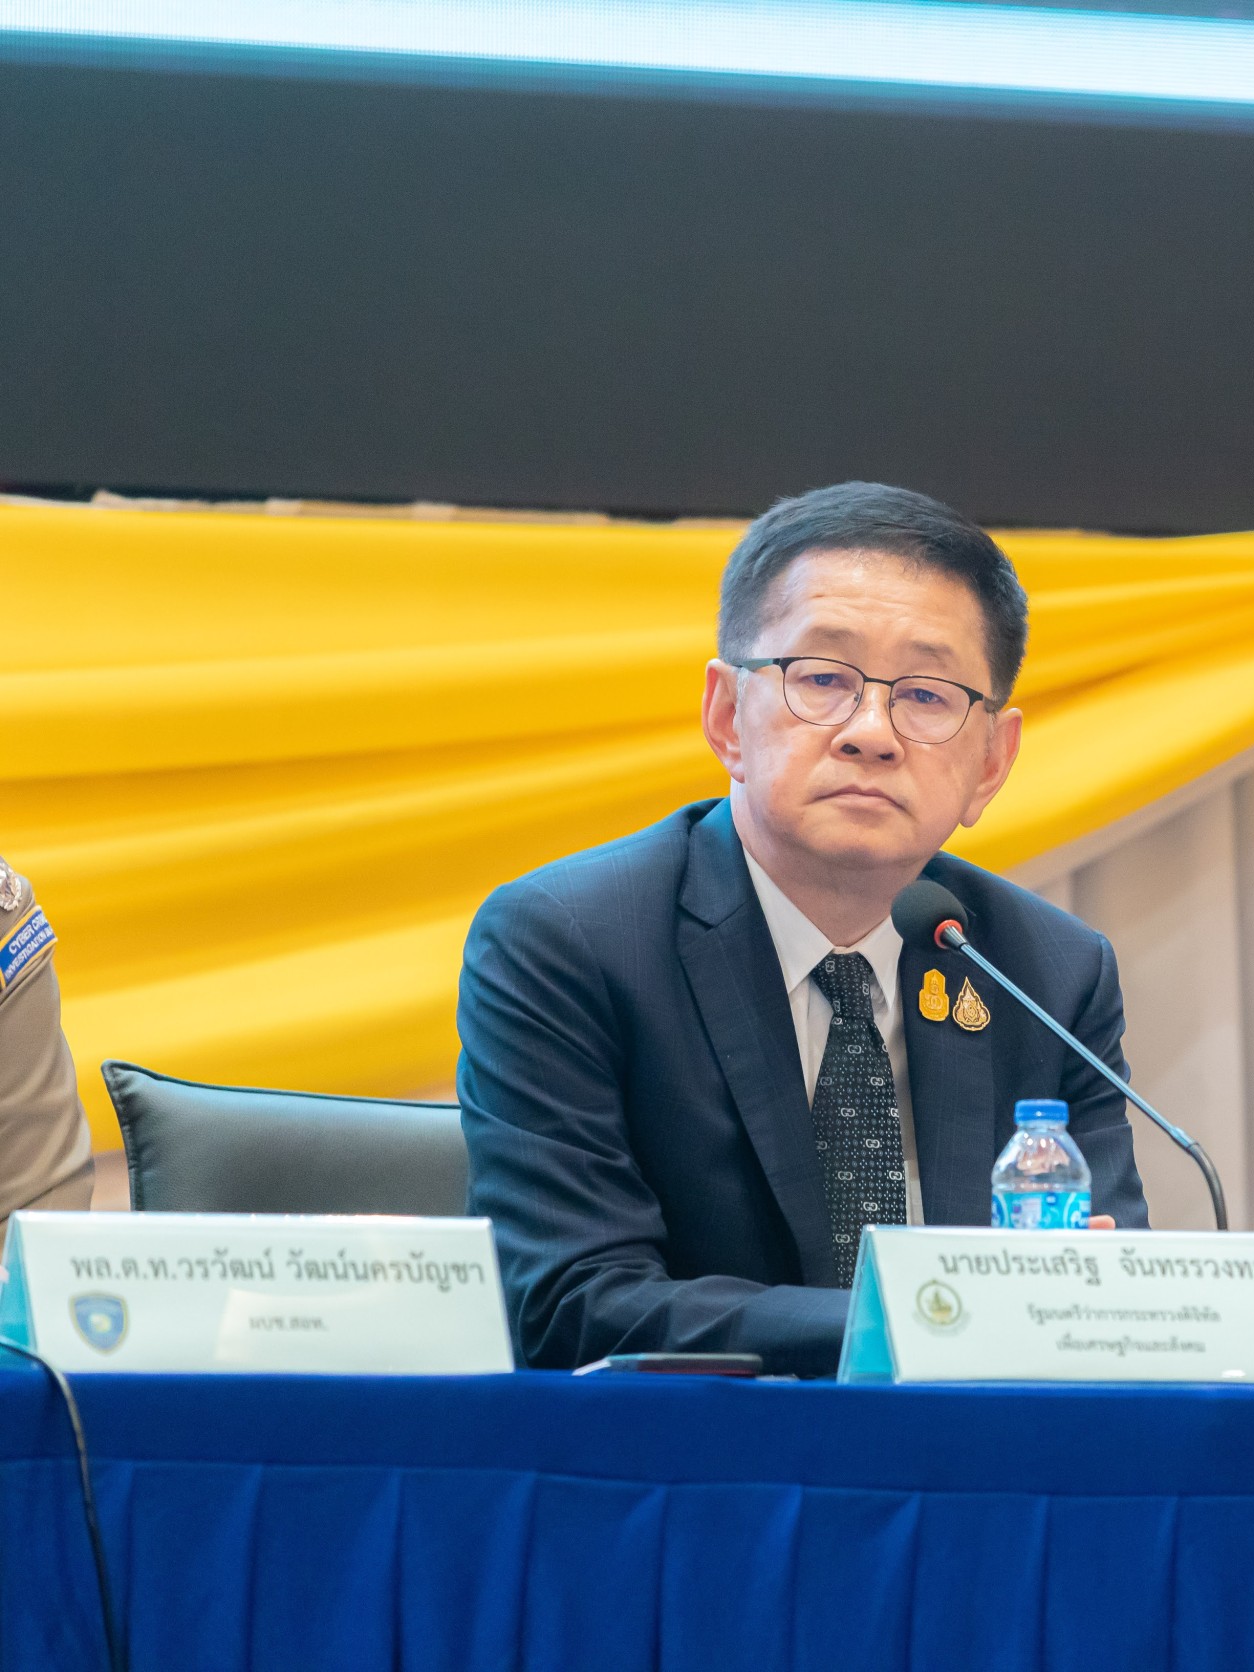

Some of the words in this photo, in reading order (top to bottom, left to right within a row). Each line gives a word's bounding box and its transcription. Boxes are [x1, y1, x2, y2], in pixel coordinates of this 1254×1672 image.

[8, 923, 35, 955] CYBER
[69, 1247, 276, 1283] พล.ต.ท.วรวัฒน์
[284, 1246, 487, 1295] วัฒน์นครบัญชา
[937, 1247, 1102, 1287] นายประเสริฐ
